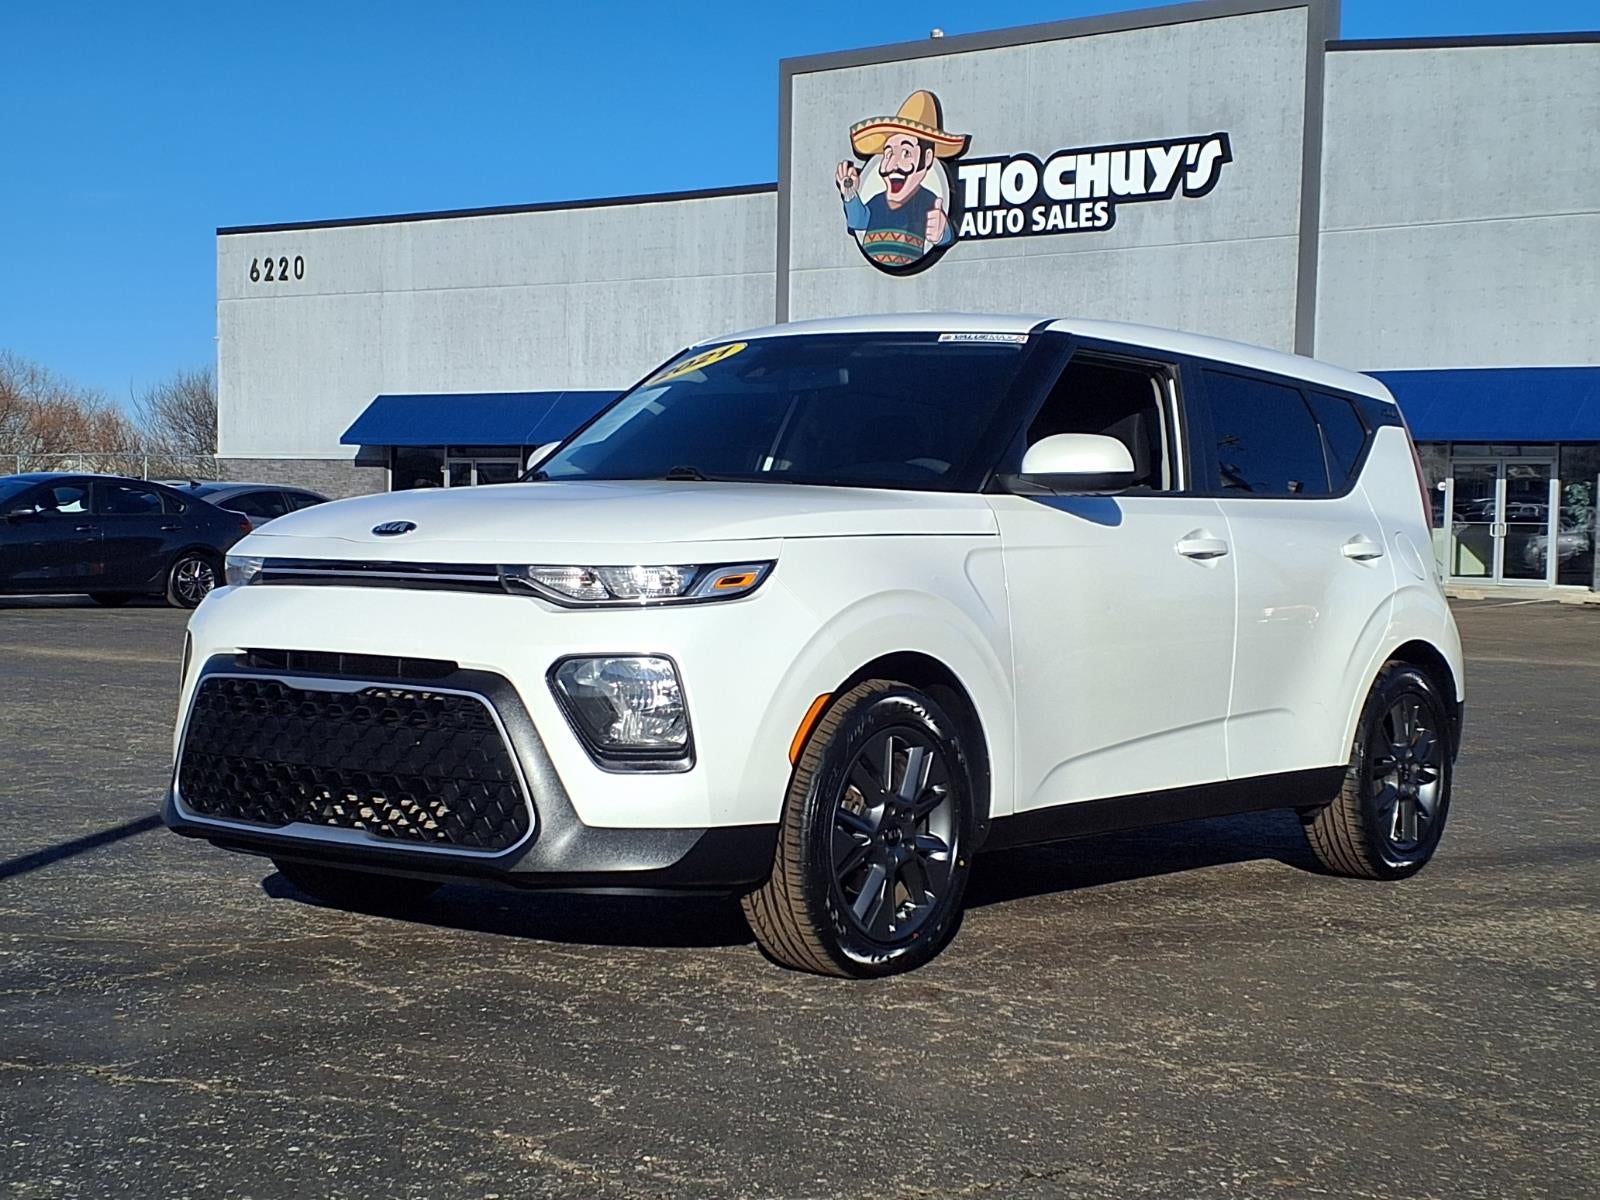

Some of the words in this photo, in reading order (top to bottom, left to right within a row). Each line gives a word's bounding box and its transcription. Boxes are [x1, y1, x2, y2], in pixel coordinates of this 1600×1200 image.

[959, 160, 1039, 208] TIO
[1043, 139, 1222, 201] CHUY'S
[959, 208, 1024, 237] AUTO
[1032, 202, 1108, 231] SALES
[250, 256, 304, 282] 6220
